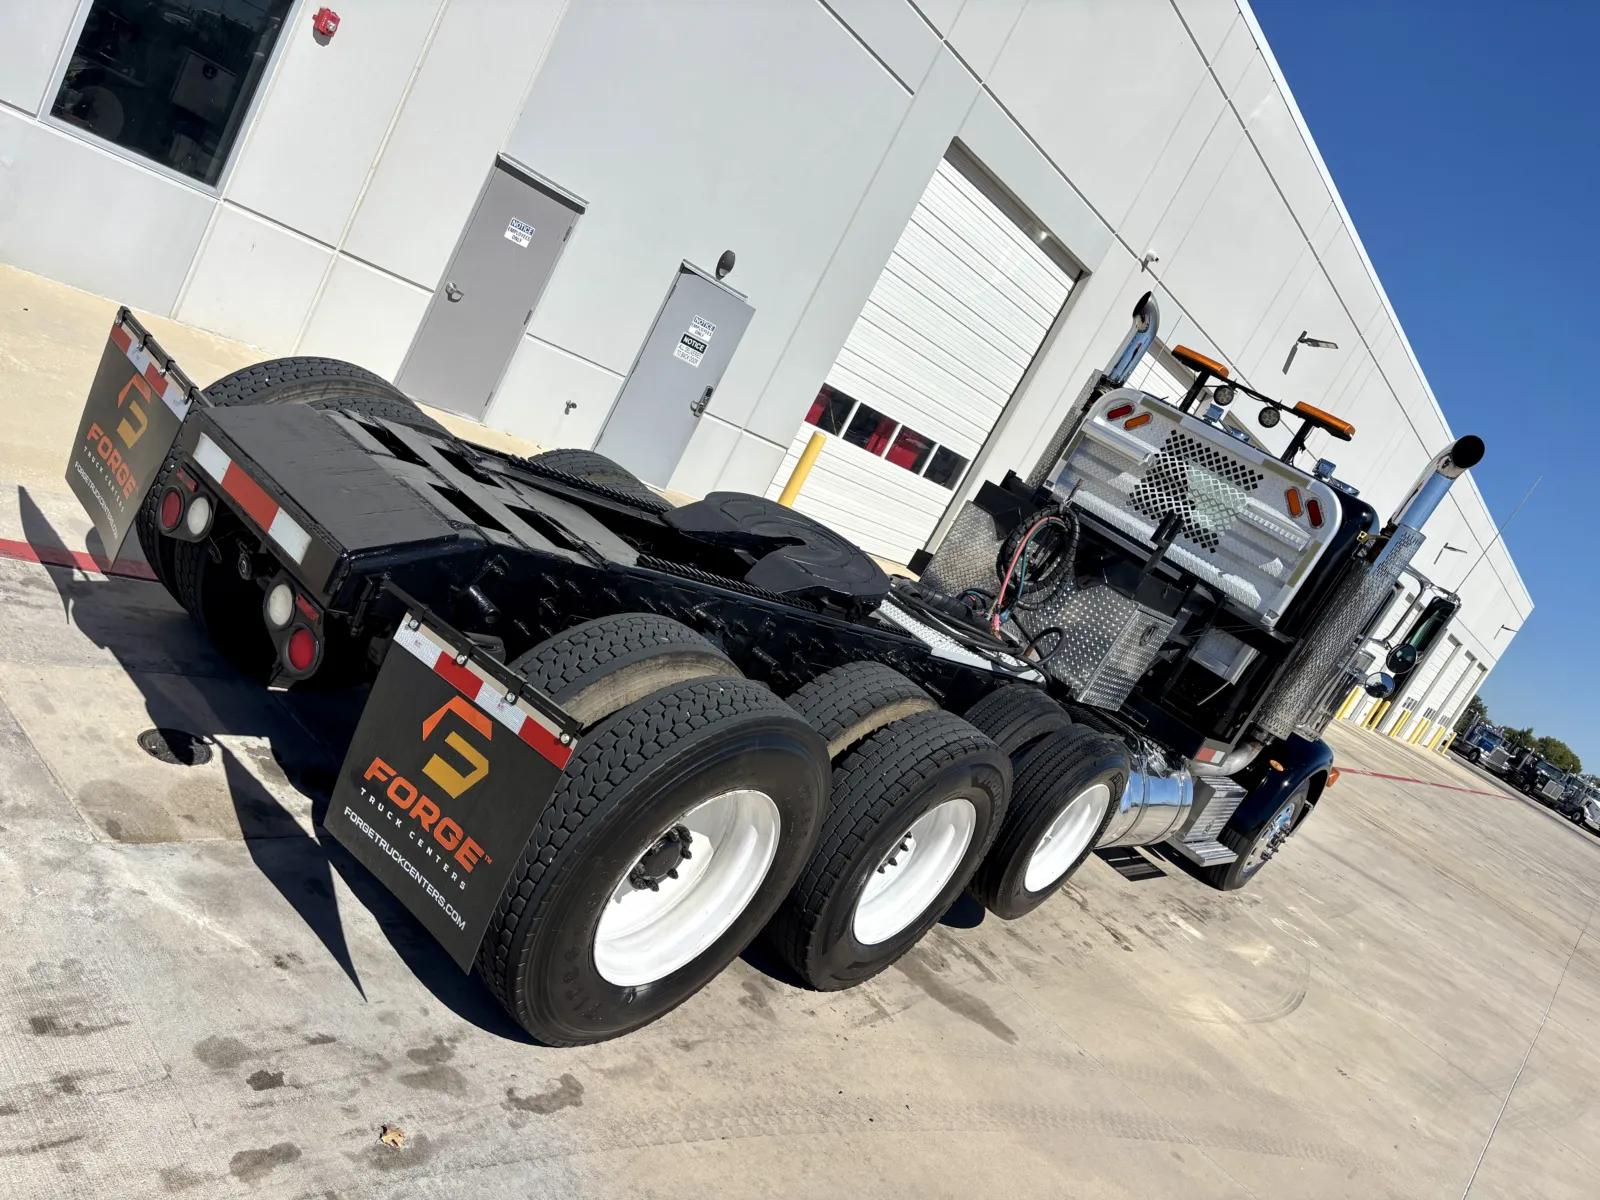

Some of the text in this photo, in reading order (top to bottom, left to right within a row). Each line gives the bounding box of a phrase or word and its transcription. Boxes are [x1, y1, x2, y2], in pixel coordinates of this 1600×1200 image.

[511, 219, 534, 236] NOTICE
[512, 234, 522, 243] ONLY
[683, 336, 705, 352] NOTICE
[694, 316, 716, 331] NOTICE
[83, 446, 124, 513] TRUCK CENTERS
[87, 422, 137, 500] FORGE
[360, 787, 466, 890] TRUCK CENTERS
[363, 757, 485, 873] FORGE
[344, 806, 467, 931] FORGETRUCKCENTERS.COM
